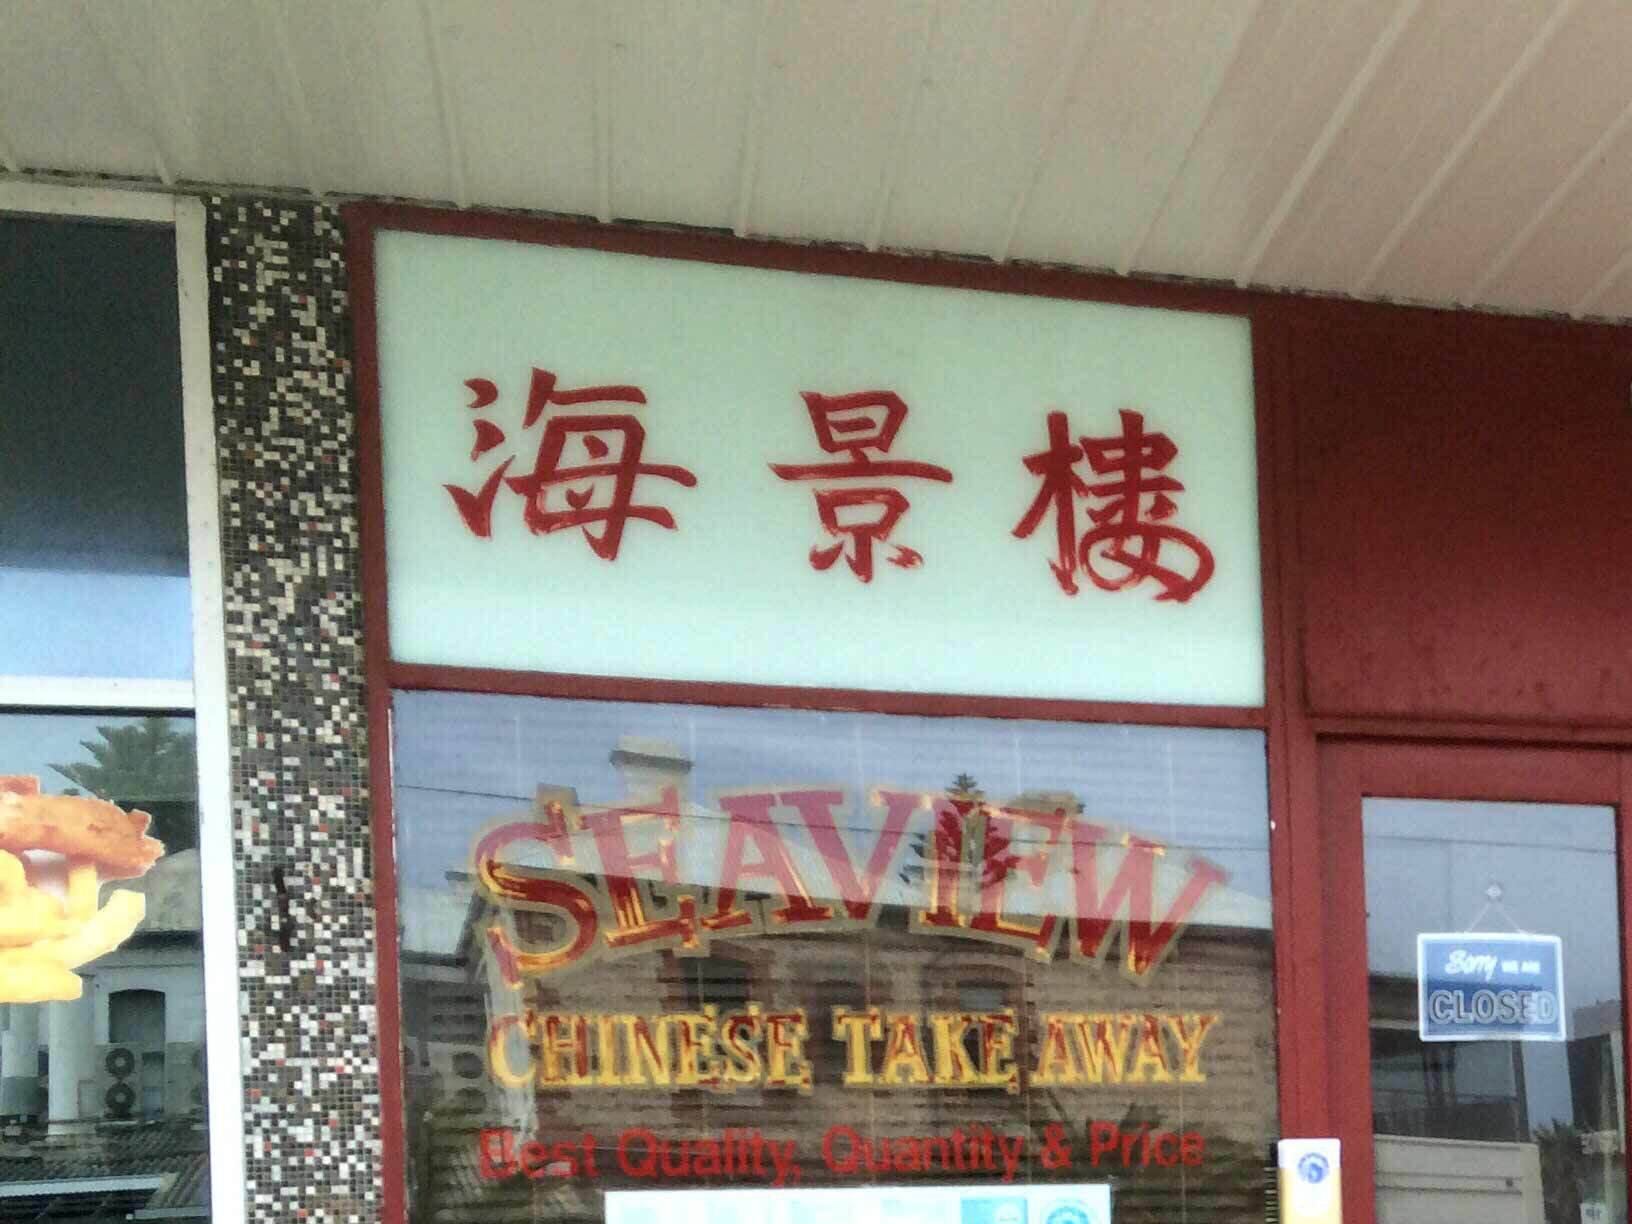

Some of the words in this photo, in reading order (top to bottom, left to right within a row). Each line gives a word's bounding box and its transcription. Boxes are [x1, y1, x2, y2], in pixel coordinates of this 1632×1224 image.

[443, 367, 1215, 602] 海景樓
[473, 783, 1226, 990] SEAVIEW
[1444, 949, 1498, 982] Sorry
[1428, 989, 1560, 1025] CLOSED
[487, 1004, 812, 1093] CHINESE
[832, 1005, 1019, 1093] TAKE
[1030, 1010, 1219, 1086] AWAY
[479, 1127, 598, 1179] Best
[617, 1127, 800, 1188] Quality,
[822, 1124, 1025, 1181] Quantity
[1040, 1122, 1072, 1168] &
[1089, 1121, 1205, 1168] Price
